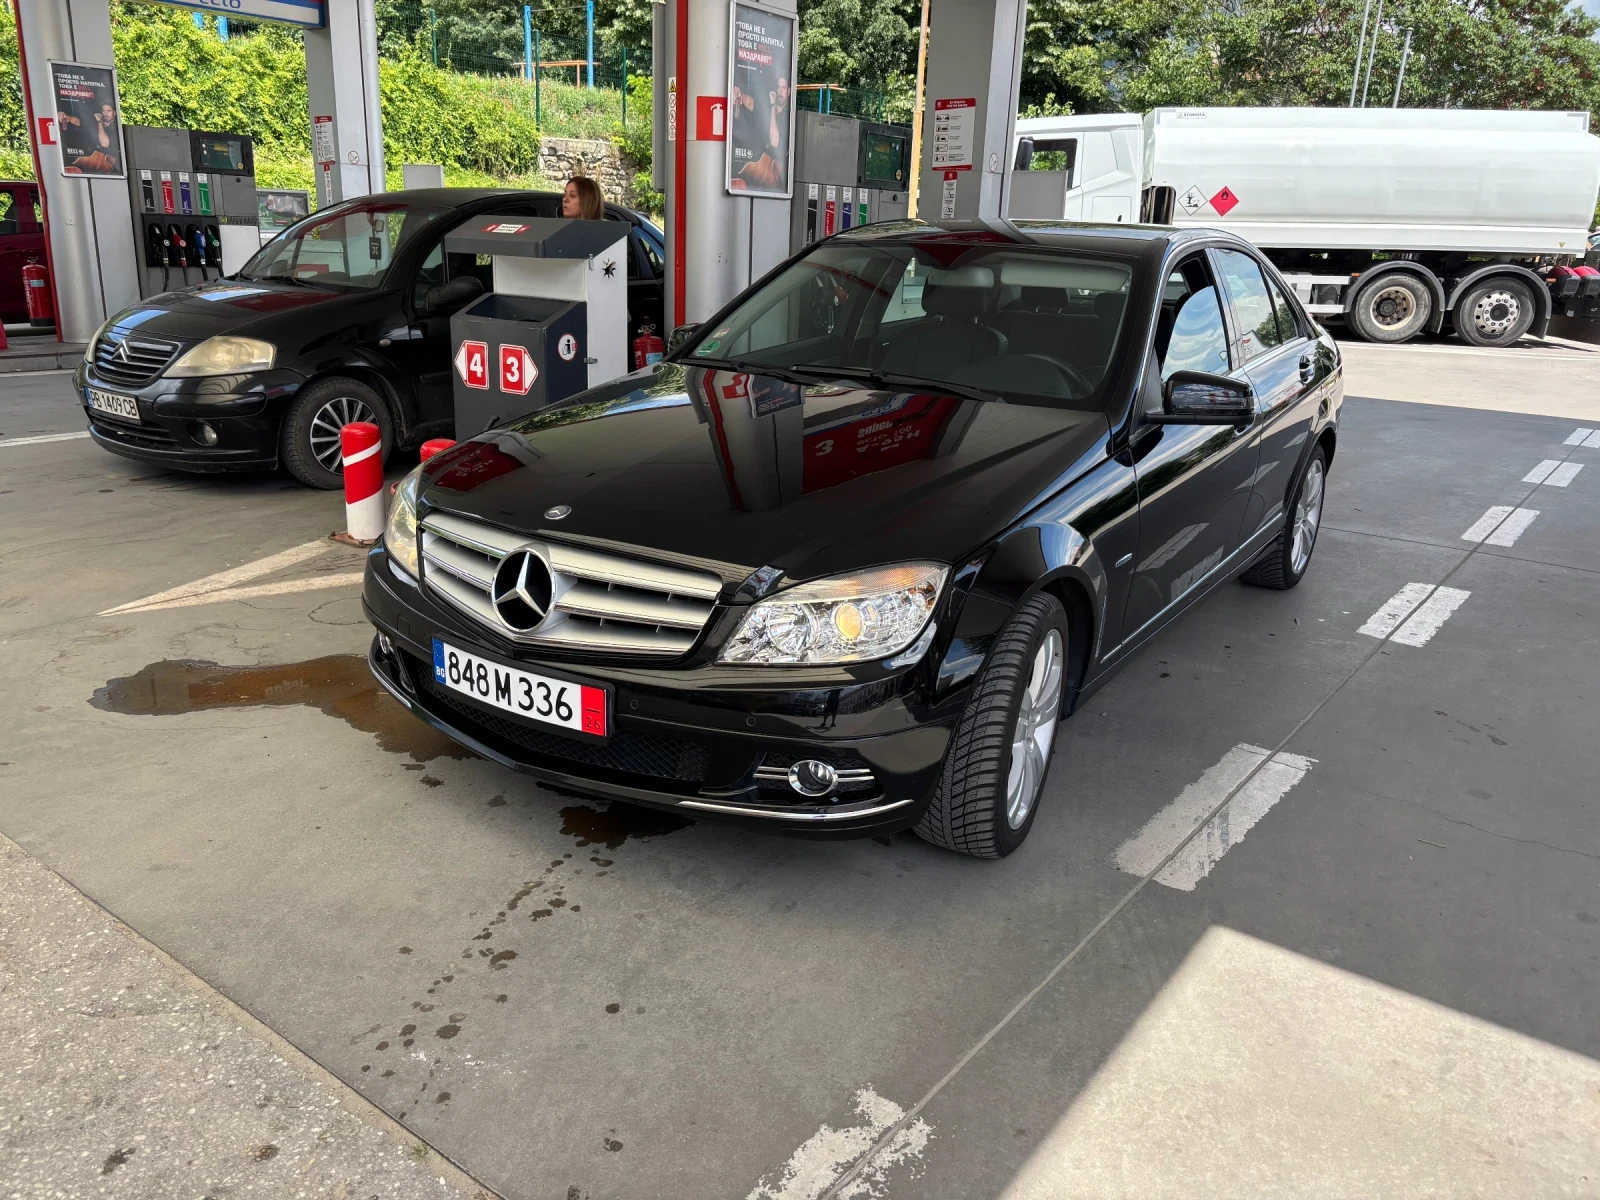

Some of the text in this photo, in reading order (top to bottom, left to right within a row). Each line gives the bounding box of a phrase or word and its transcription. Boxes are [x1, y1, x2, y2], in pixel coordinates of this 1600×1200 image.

[738, 30, 760, 42] ПРОСТО
[738, 39, 753, 50] ТОВА
[470, 353, 483, 378] 4
[505, 356, 520, 383] 3
[102, 394, 122, 414] 1409
[122, 398, 138, 416] CB
[436, 665, 446, 678] BG
[448, 652, 573, 722] 848 M 336
[586, 717, 601, 730] 26
